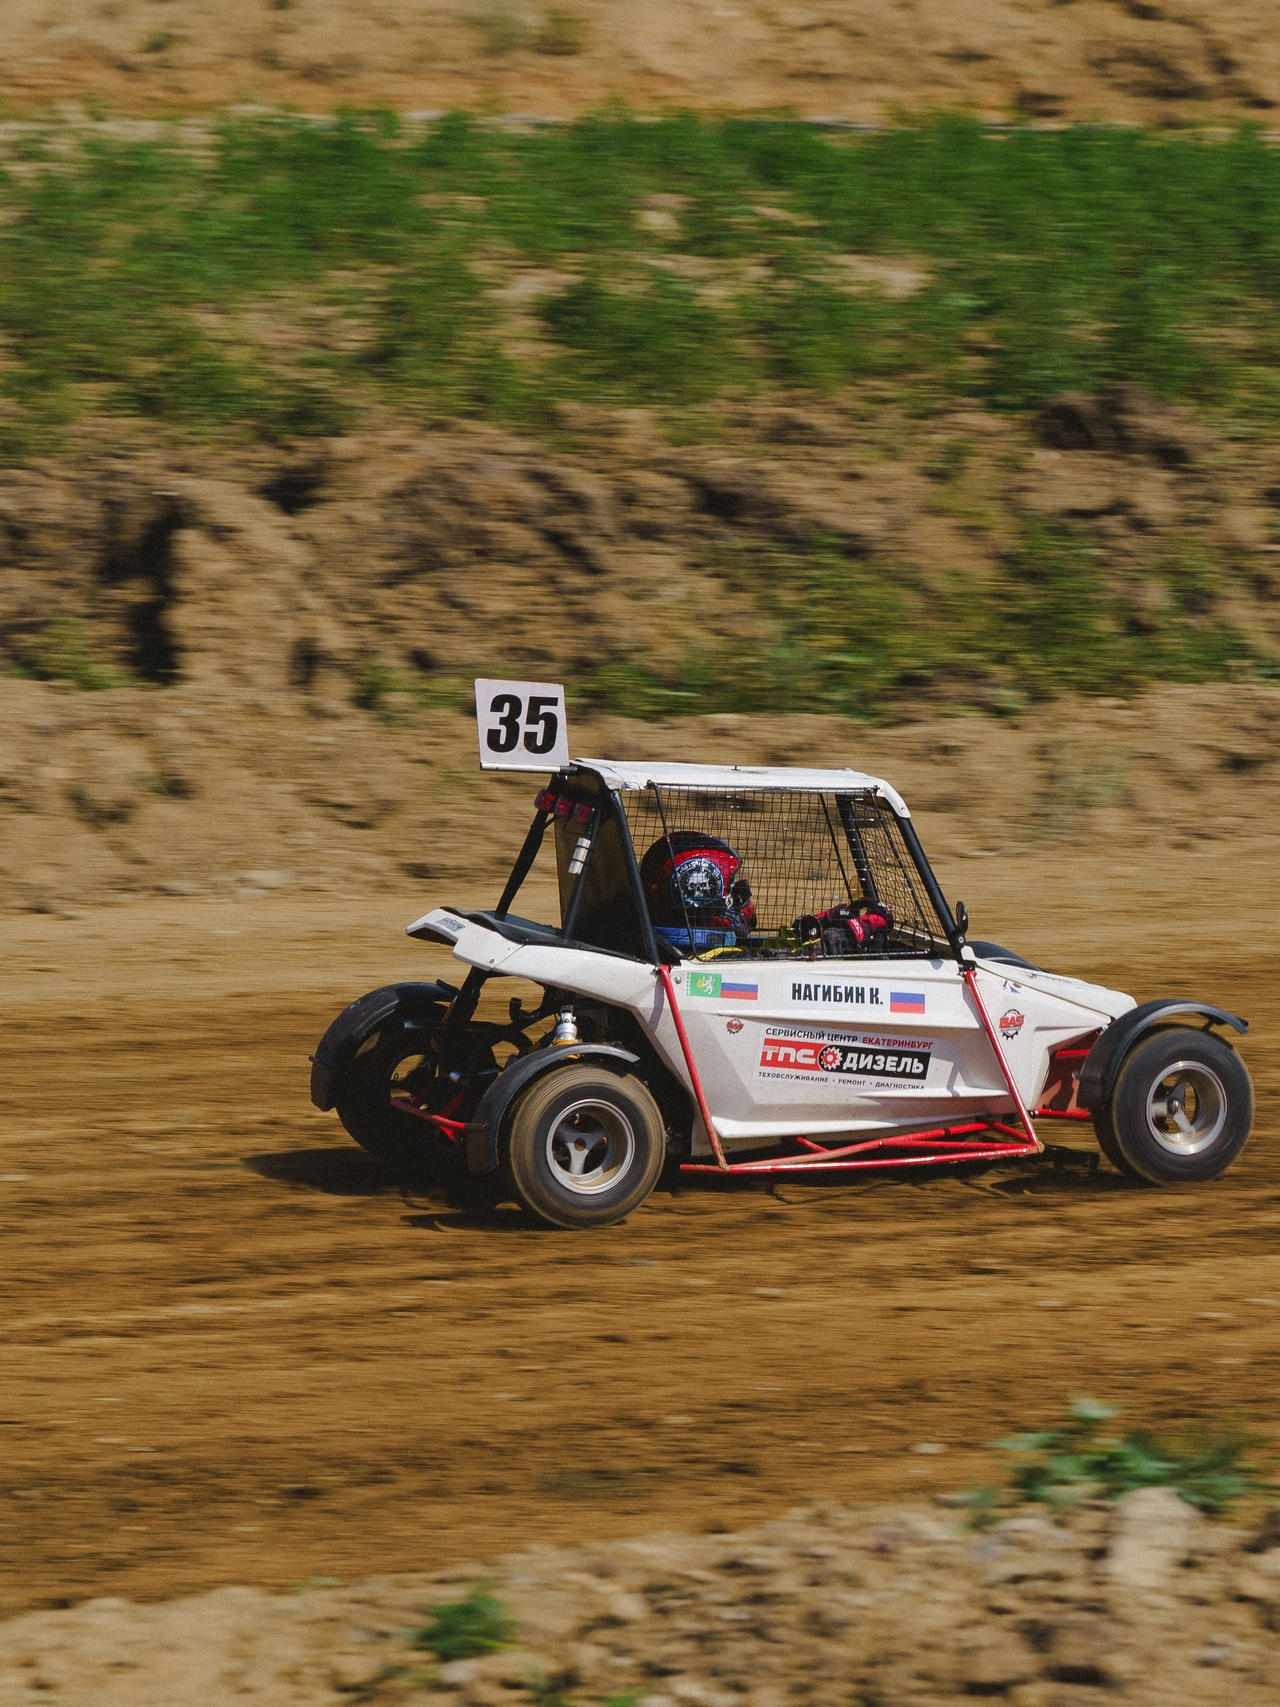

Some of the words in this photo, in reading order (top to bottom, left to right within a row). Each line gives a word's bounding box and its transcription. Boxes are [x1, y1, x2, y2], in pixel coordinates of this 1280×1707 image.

[487, 693, 559, 755] 35
[791, 982, 865, 1004] НАГИБИН
[869, 987, 884, 1005] К.
[765, 1027, 826, 1041] СЕРВИСНЫЙ
[827, 1033, 858, 1043] ЦЕНТР
[862, 1036, 934, 1050] ЕКАТЕРИНБУРГ
[842, 1052, 925, 1074] ДИЗЕЛЬ
[758, 1071, 829, 1083] ТЕХОБСЛУЖИВАНИЕ
[838, 1078, 866, 1087] РЕМОНТ
[875, 1081, 925, 1091] ДИАГНОСТИКА
